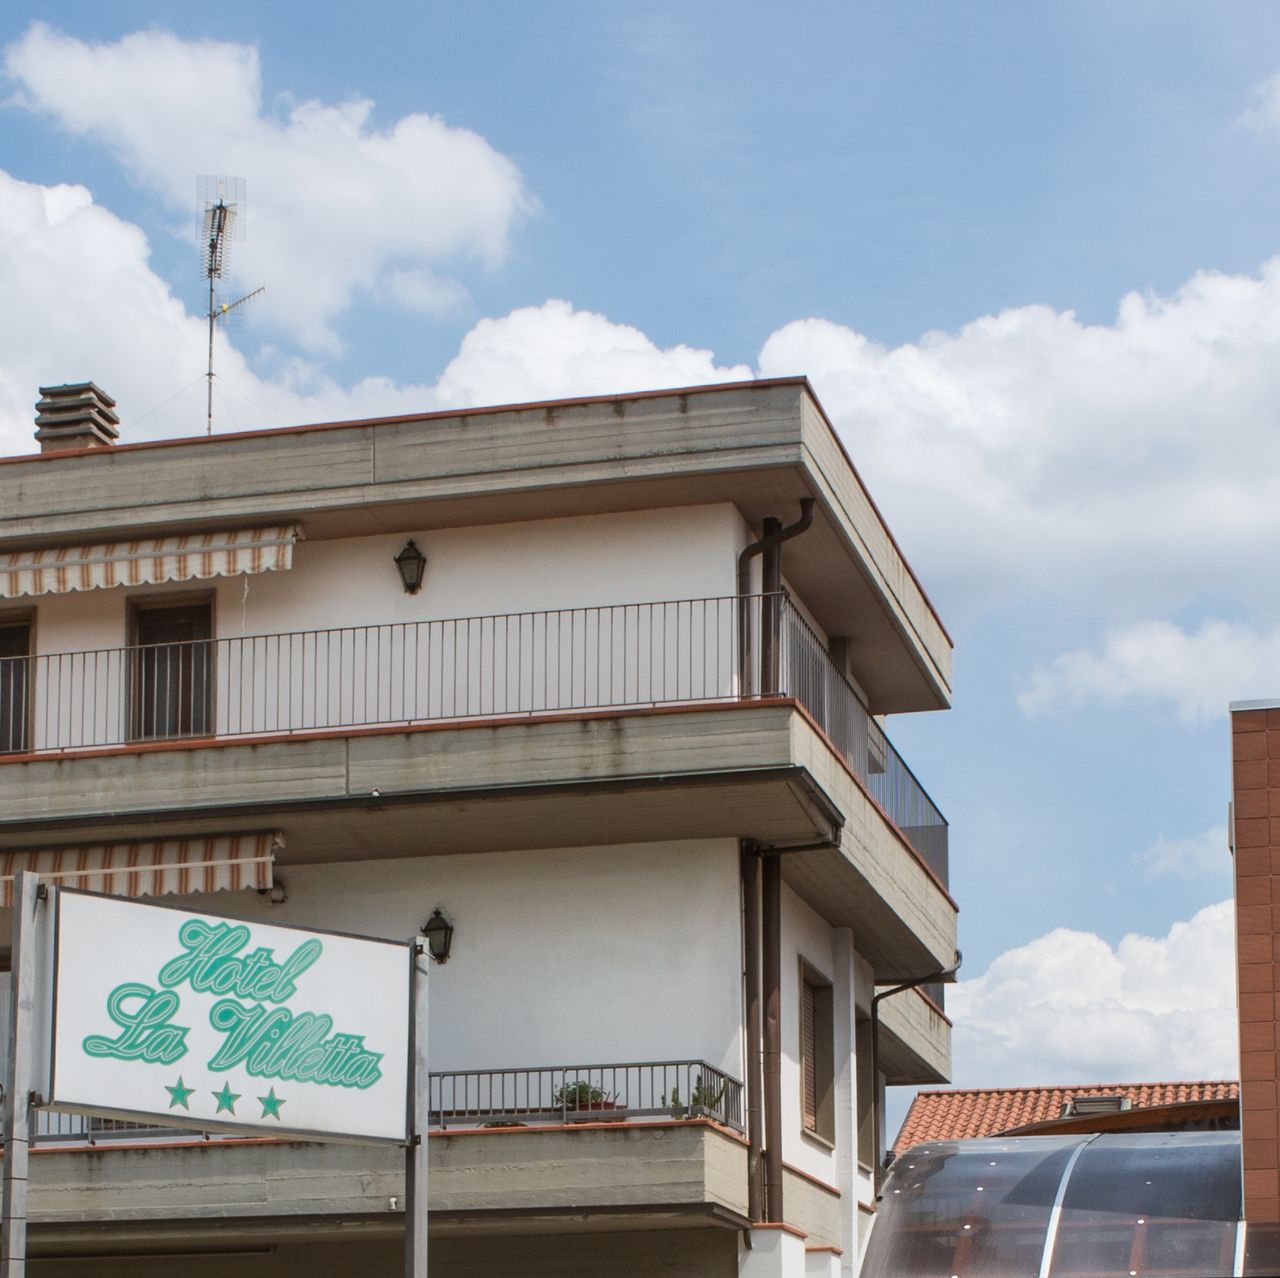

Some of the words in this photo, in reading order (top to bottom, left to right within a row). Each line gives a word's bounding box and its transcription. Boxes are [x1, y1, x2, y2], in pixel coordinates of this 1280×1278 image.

[159, 919, 322, 1002] Hotel
[82, 983, 191, 1065] La
[208, 999, 384, 1089] Villetta
